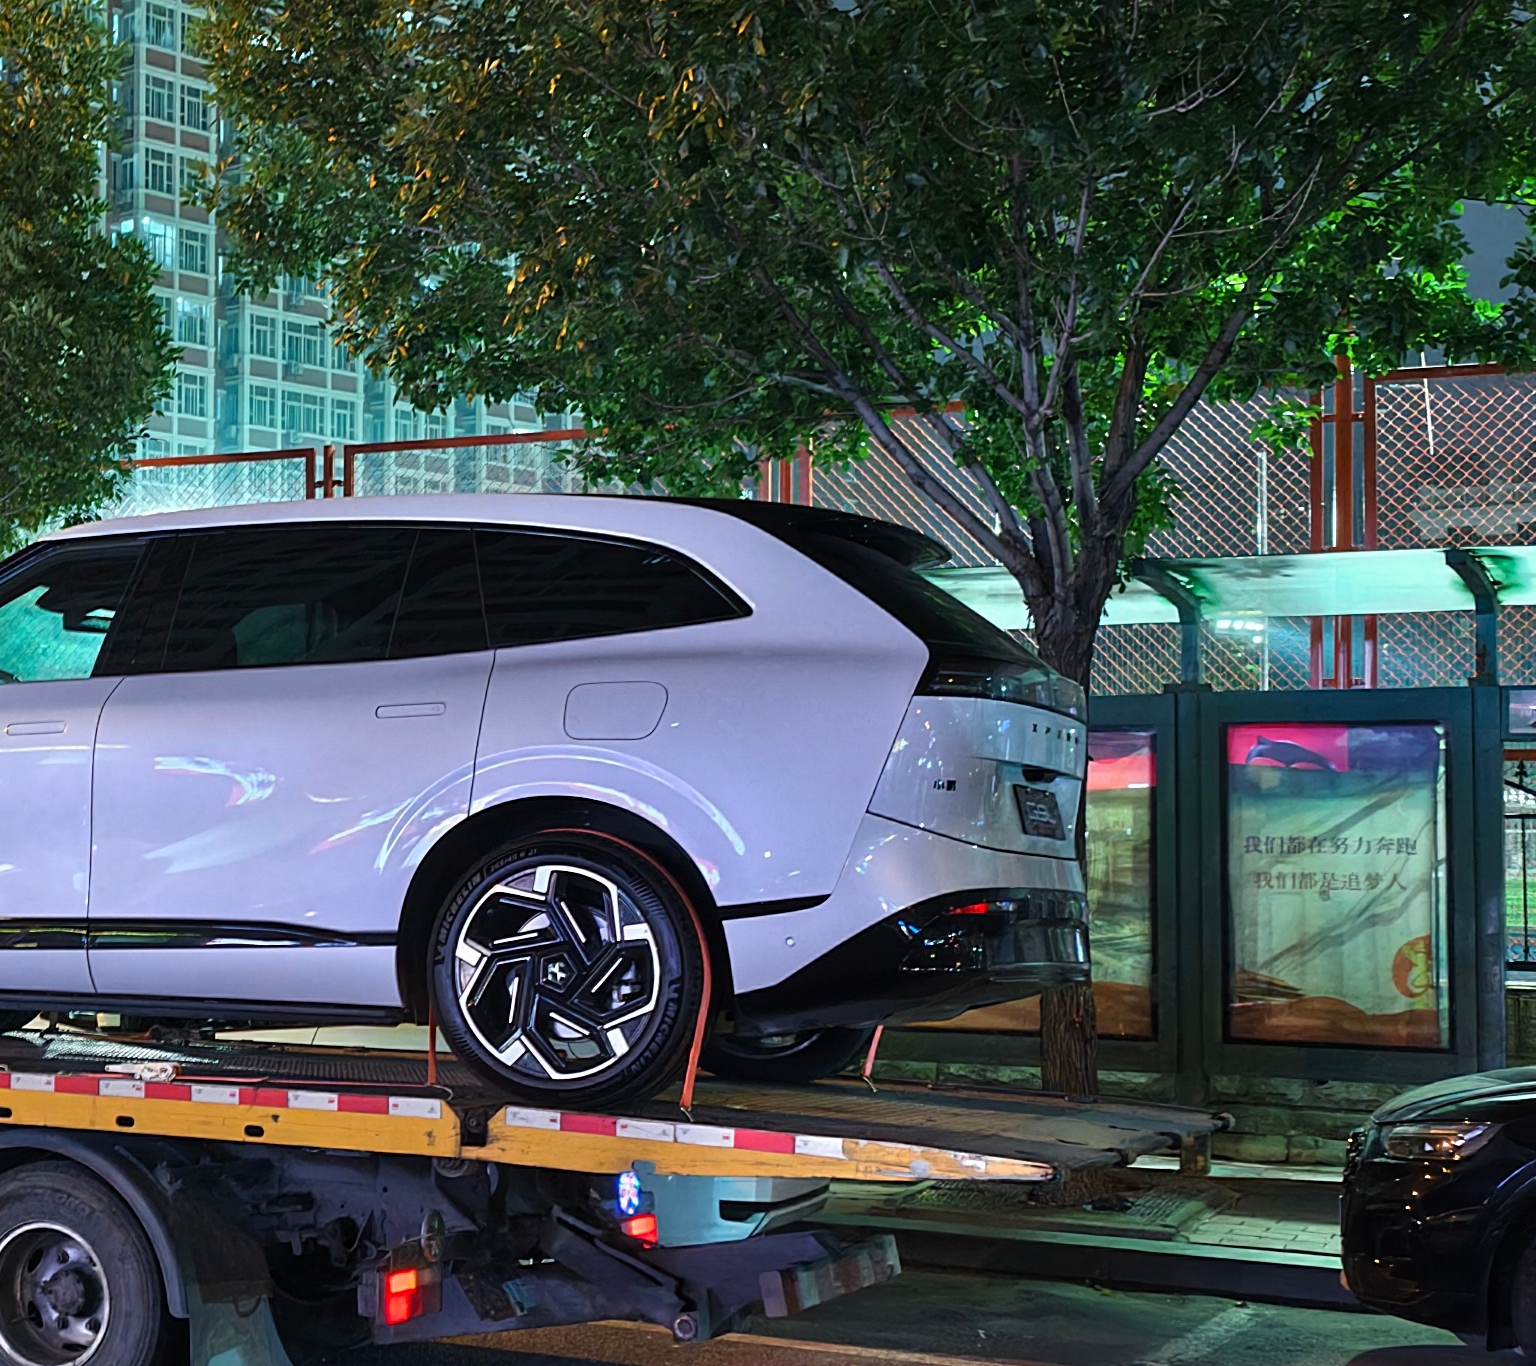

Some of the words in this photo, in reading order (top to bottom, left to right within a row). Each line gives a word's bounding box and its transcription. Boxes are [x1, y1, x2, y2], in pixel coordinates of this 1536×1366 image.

[1244, 836, 1418, 856] 我们都在努力奔跑
[1253, 871, 1407, 892] 我们都是追梦人
